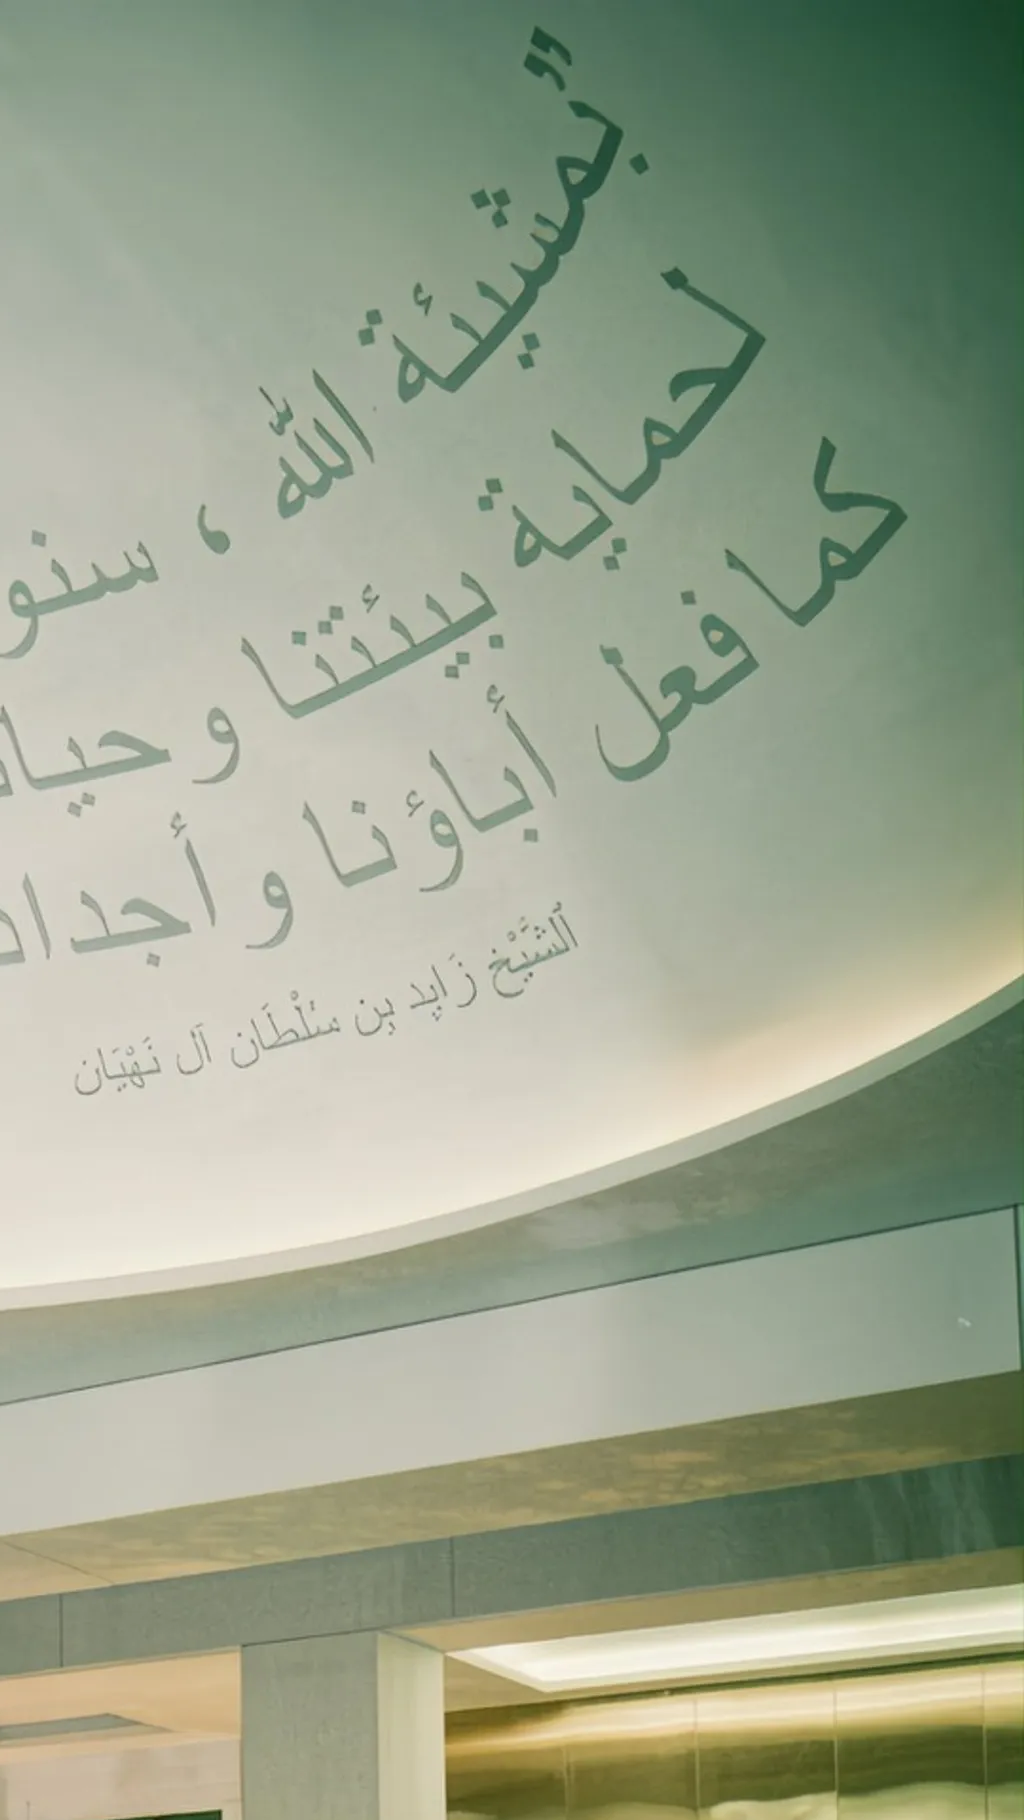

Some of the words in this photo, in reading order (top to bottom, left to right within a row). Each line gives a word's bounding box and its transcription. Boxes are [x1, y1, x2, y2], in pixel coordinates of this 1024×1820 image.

[478, 266, 767, 571] لحماية
[724, 436, 908, 627] كما
[241, 572, 505, 719] بيئتنا
[595, 590, 760, 782] فعل
